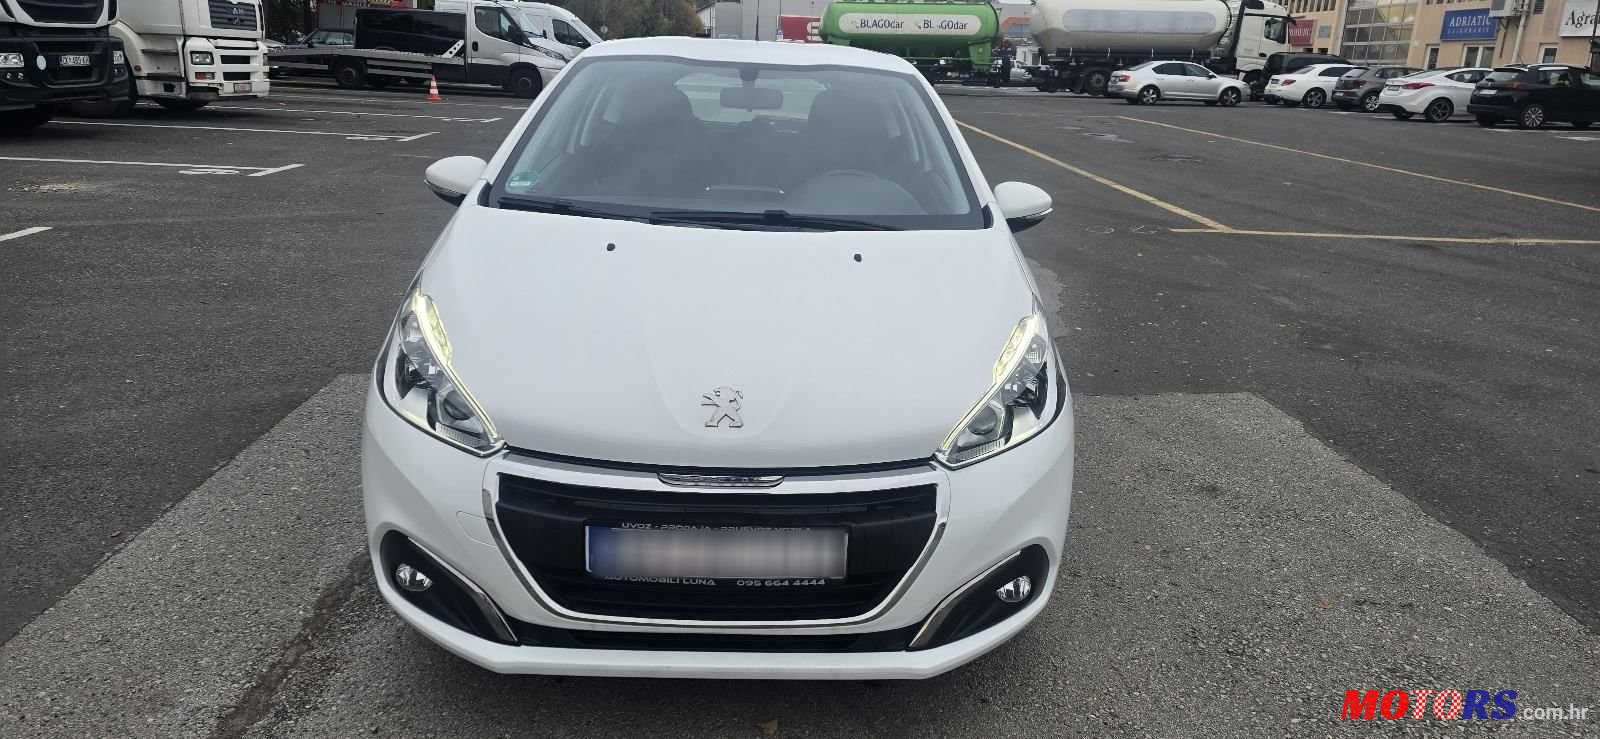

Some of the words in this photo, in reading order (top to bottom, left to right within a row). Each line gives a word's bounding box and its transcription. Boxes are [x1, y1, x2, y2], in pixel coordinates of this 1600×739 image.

[860, 18, 904, 29] BLAGOdar
[923, 19, 968, 30] BLGOdar
[1449, 15, 1491, 27] ADRIATIC
[604, 576, 680, 584] AUTOMOBILI
[792, 578, 826, 586] 4444
